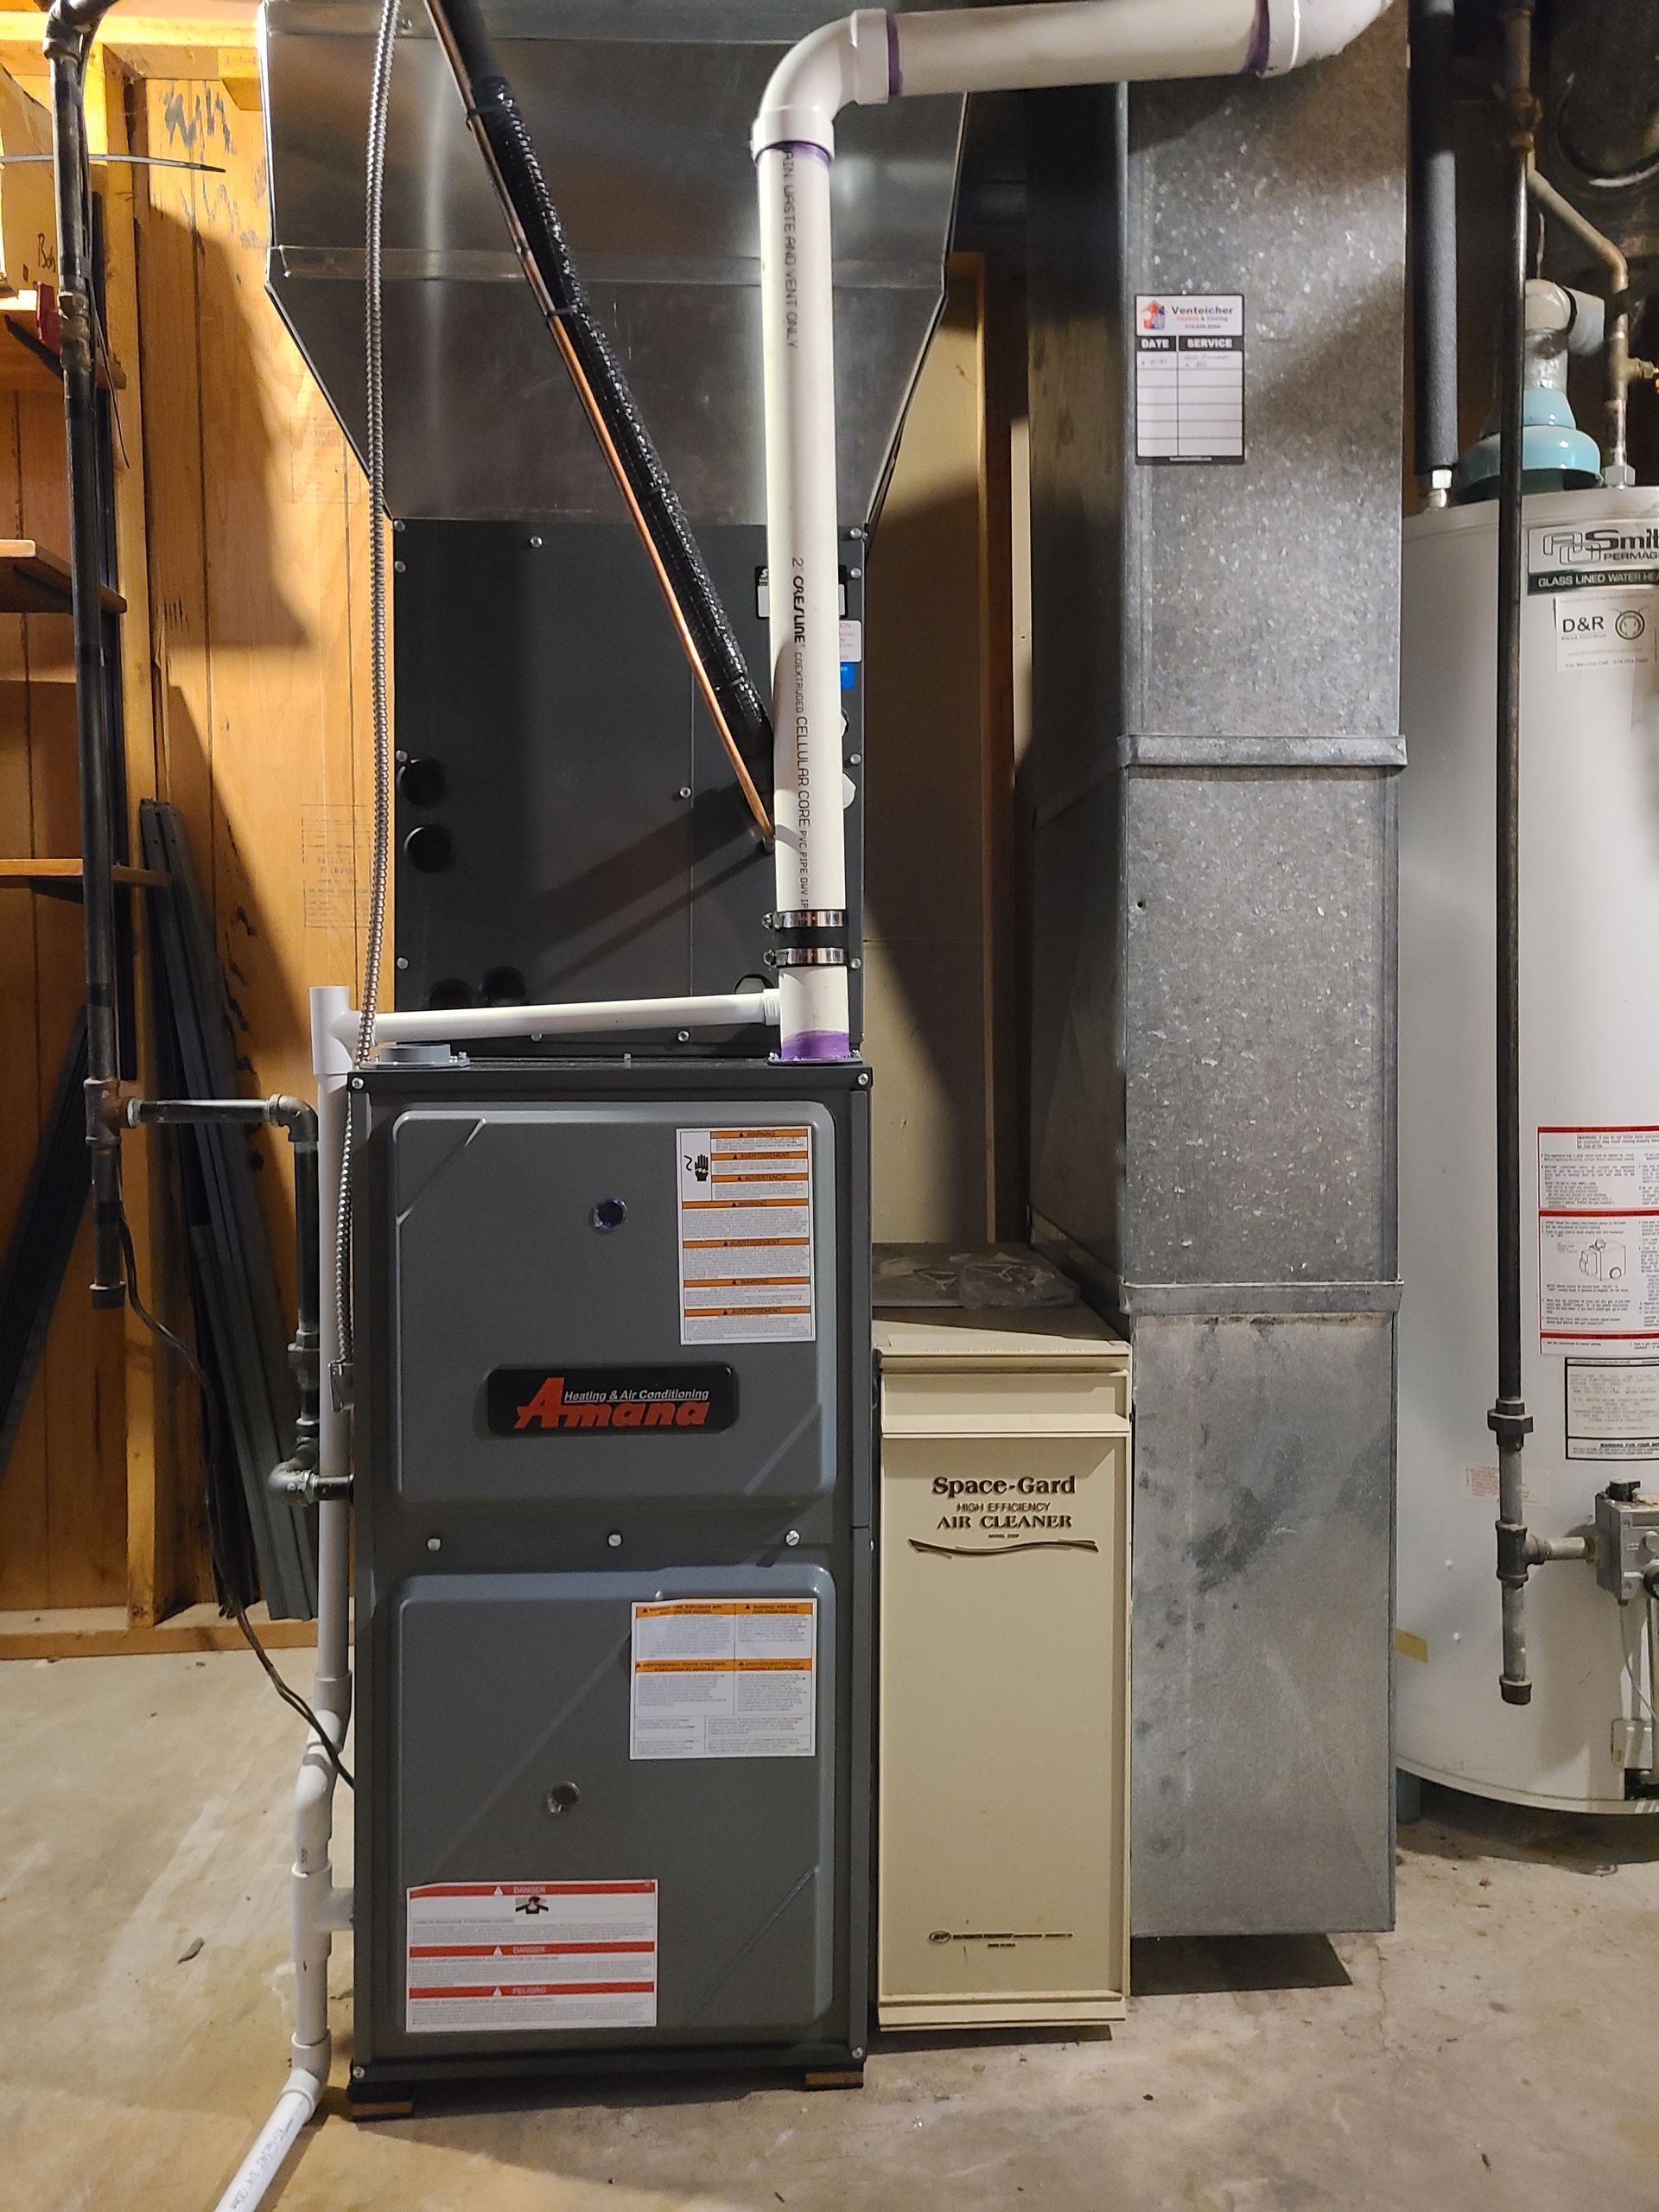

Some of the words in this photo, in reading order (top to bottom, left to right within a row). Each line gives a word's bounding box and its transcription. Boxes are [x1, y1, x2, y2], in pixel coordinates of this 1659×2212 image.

[784, 236, 797, 265] AND
[1141, 338, 1170, 349] DATE
[1186, 338, 1233, 349] SERVICE
[1538, 575, 1573, 588] GLASS
[1575, 573, 1605, 584] LINED
[1607, 573, 1641, 583] WATER
[1562, 615, 1605, 632] D&R
[794, 652, 804, 714] COEXTRUDED
[796, 716, 810, 786] CELLULAR
[798, 790, 810, 827] CORE
[798, 830, 808, 849] PVC
[799, 852, 808, 874] PIPE
[514, 1376, 709, 1429] Amana
[564, 1389, 606, 1402] Heating
[609, 1390, 619, 1401] &
[620, 1389, 636, 1400] Air
[639, 1389, 709, 1401] Conditioning
[931, 1474, 1076, 1499] Space-Gard
[956, 1502, 984, 1513] HIGH
[987, 1501, 1052, 1513] EFFICIENCY
[937, 1515, 972, 1530] AIR
[980, 1514, 1072, 1529] CLEANER
[513, 1885, 547, 1894] DANGER
[512, 1945, 546, 1955] DANGER
